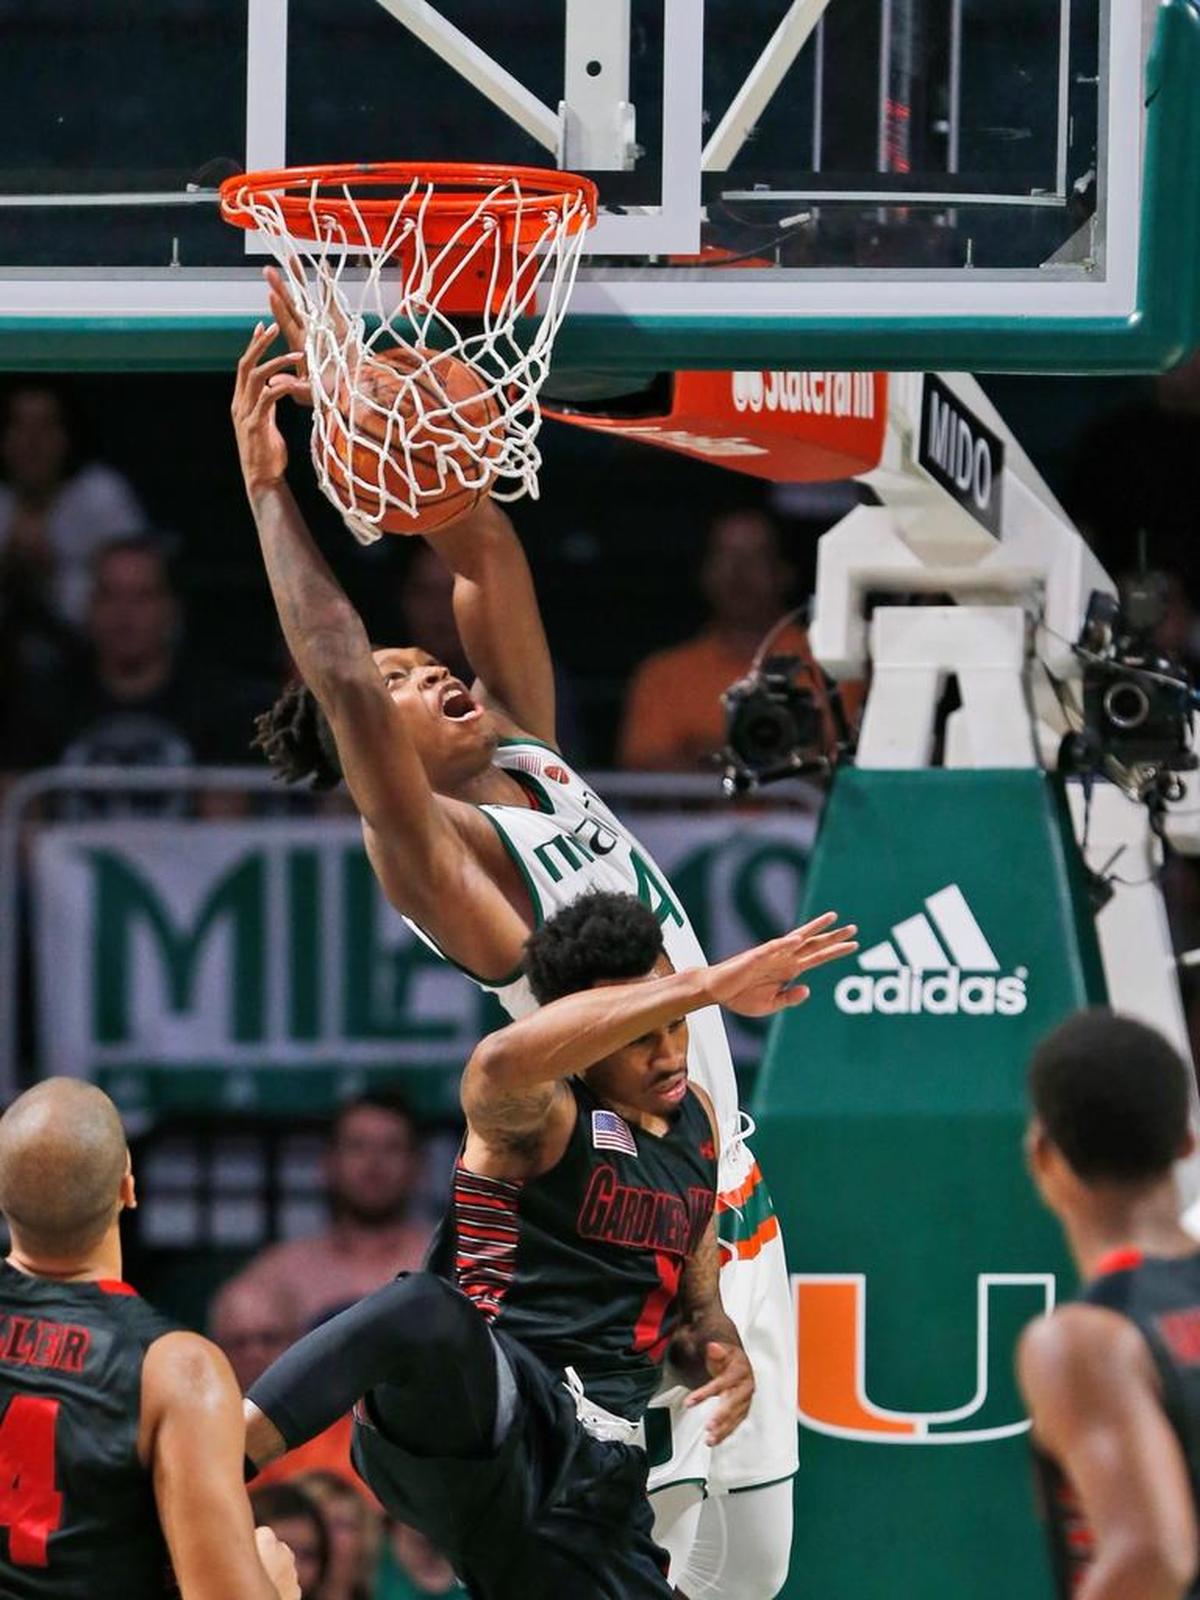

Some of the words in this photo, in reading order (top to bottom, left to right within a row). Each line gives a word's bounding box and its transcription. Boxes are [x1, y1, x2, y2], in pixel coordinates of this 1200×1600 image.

[928, 391, 992, 510] MIDO
[834, 965, 1028, 1015] adidas
[0, 1313, 93, 1374] LER
